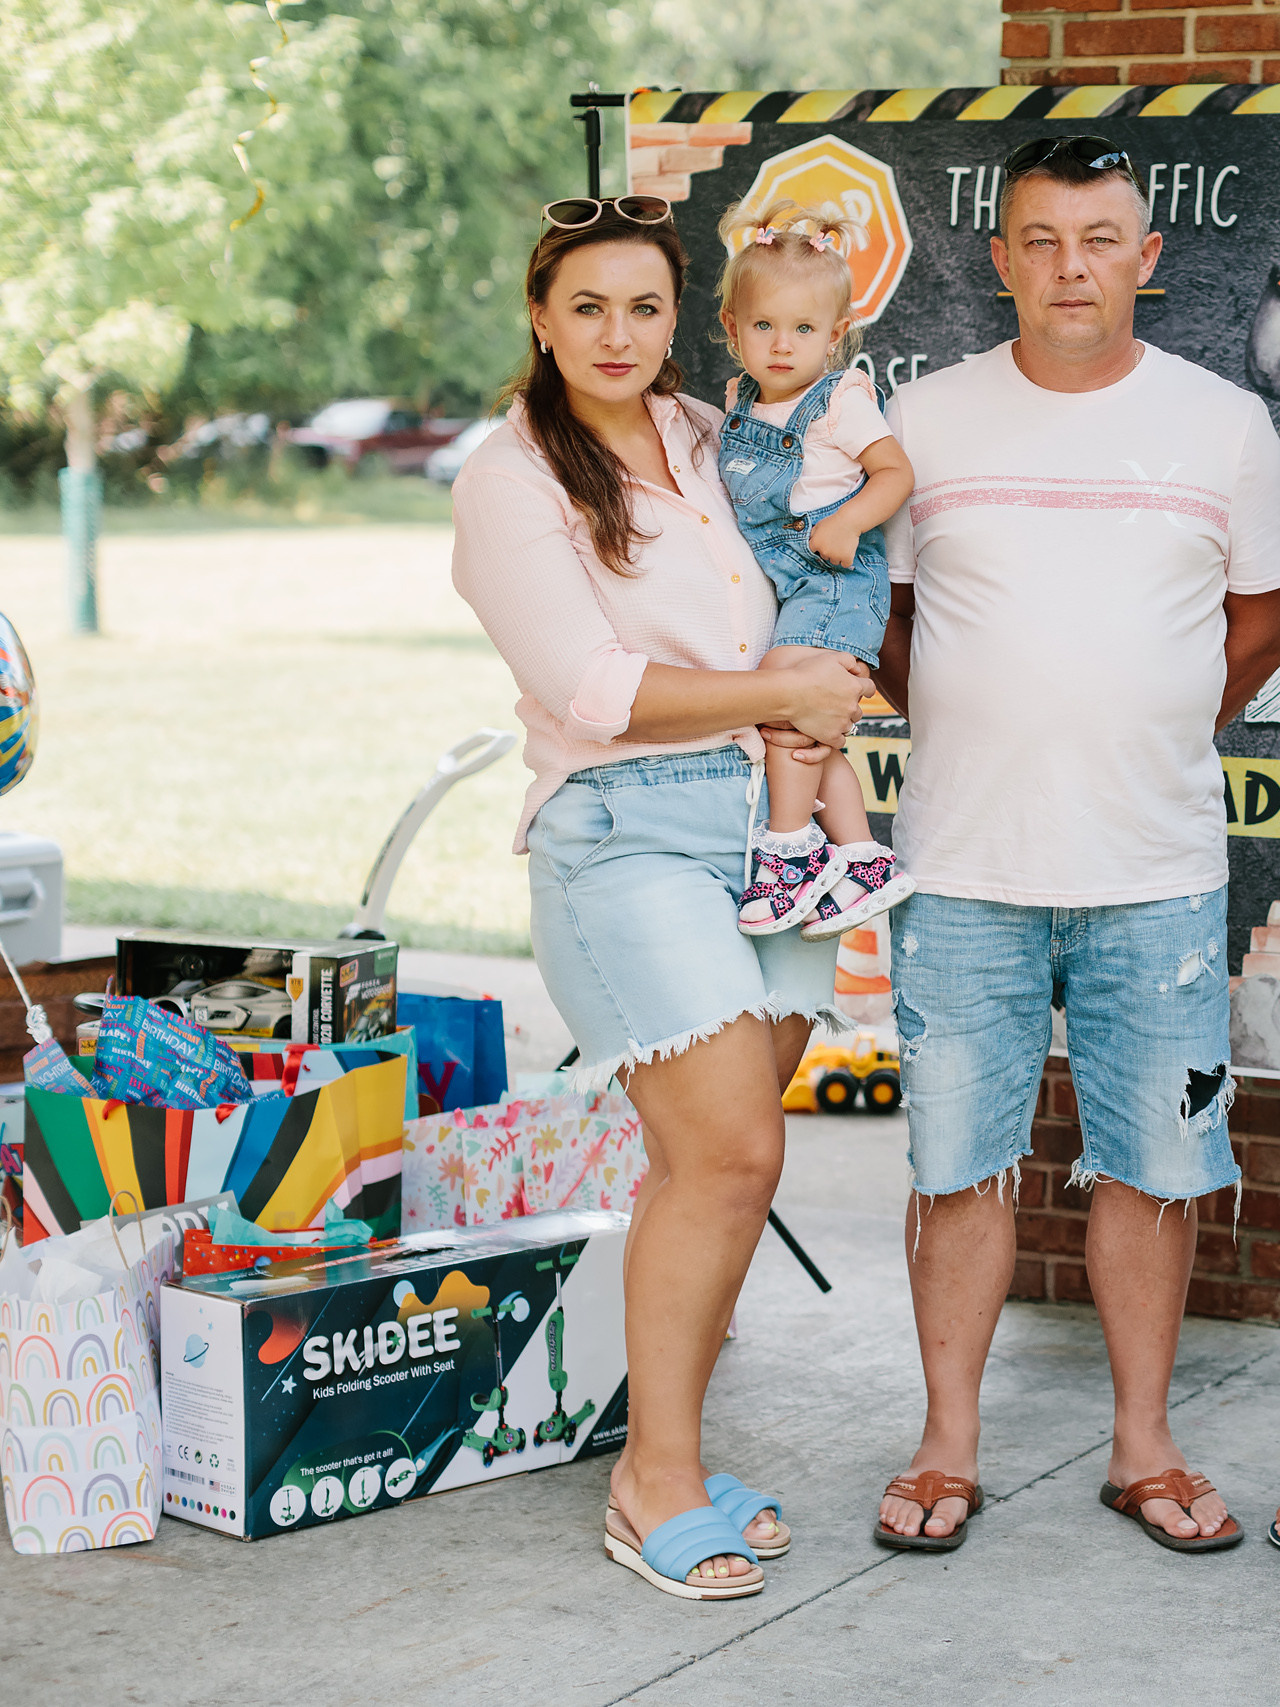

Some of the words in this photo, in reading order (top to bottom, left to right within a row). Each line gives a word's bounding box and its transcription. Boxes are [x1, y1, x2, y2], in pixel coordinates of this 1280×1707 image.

[141, 1017, 196, 1057] BIRTHDAY
[302, 1306, 462, 1381] SKIDEE
[313, 1386, 335, 1399] Kids
[337, 1377, 372, 1395] Folding
[373, 1370, 409, 1387] Scooter
[410, 1364, 433, 1378] With
[433, 1359, 456, 1373] Seat
[300, 1466, 314, 1477] The
[315, 1461, 342, 1474] scooter
[343, 1455, 363, 1467] that's
[364, 1451, 376, 1464] got
[376, 1449, 382, 1459] it
[382, 1447, 394, 1458] all!
